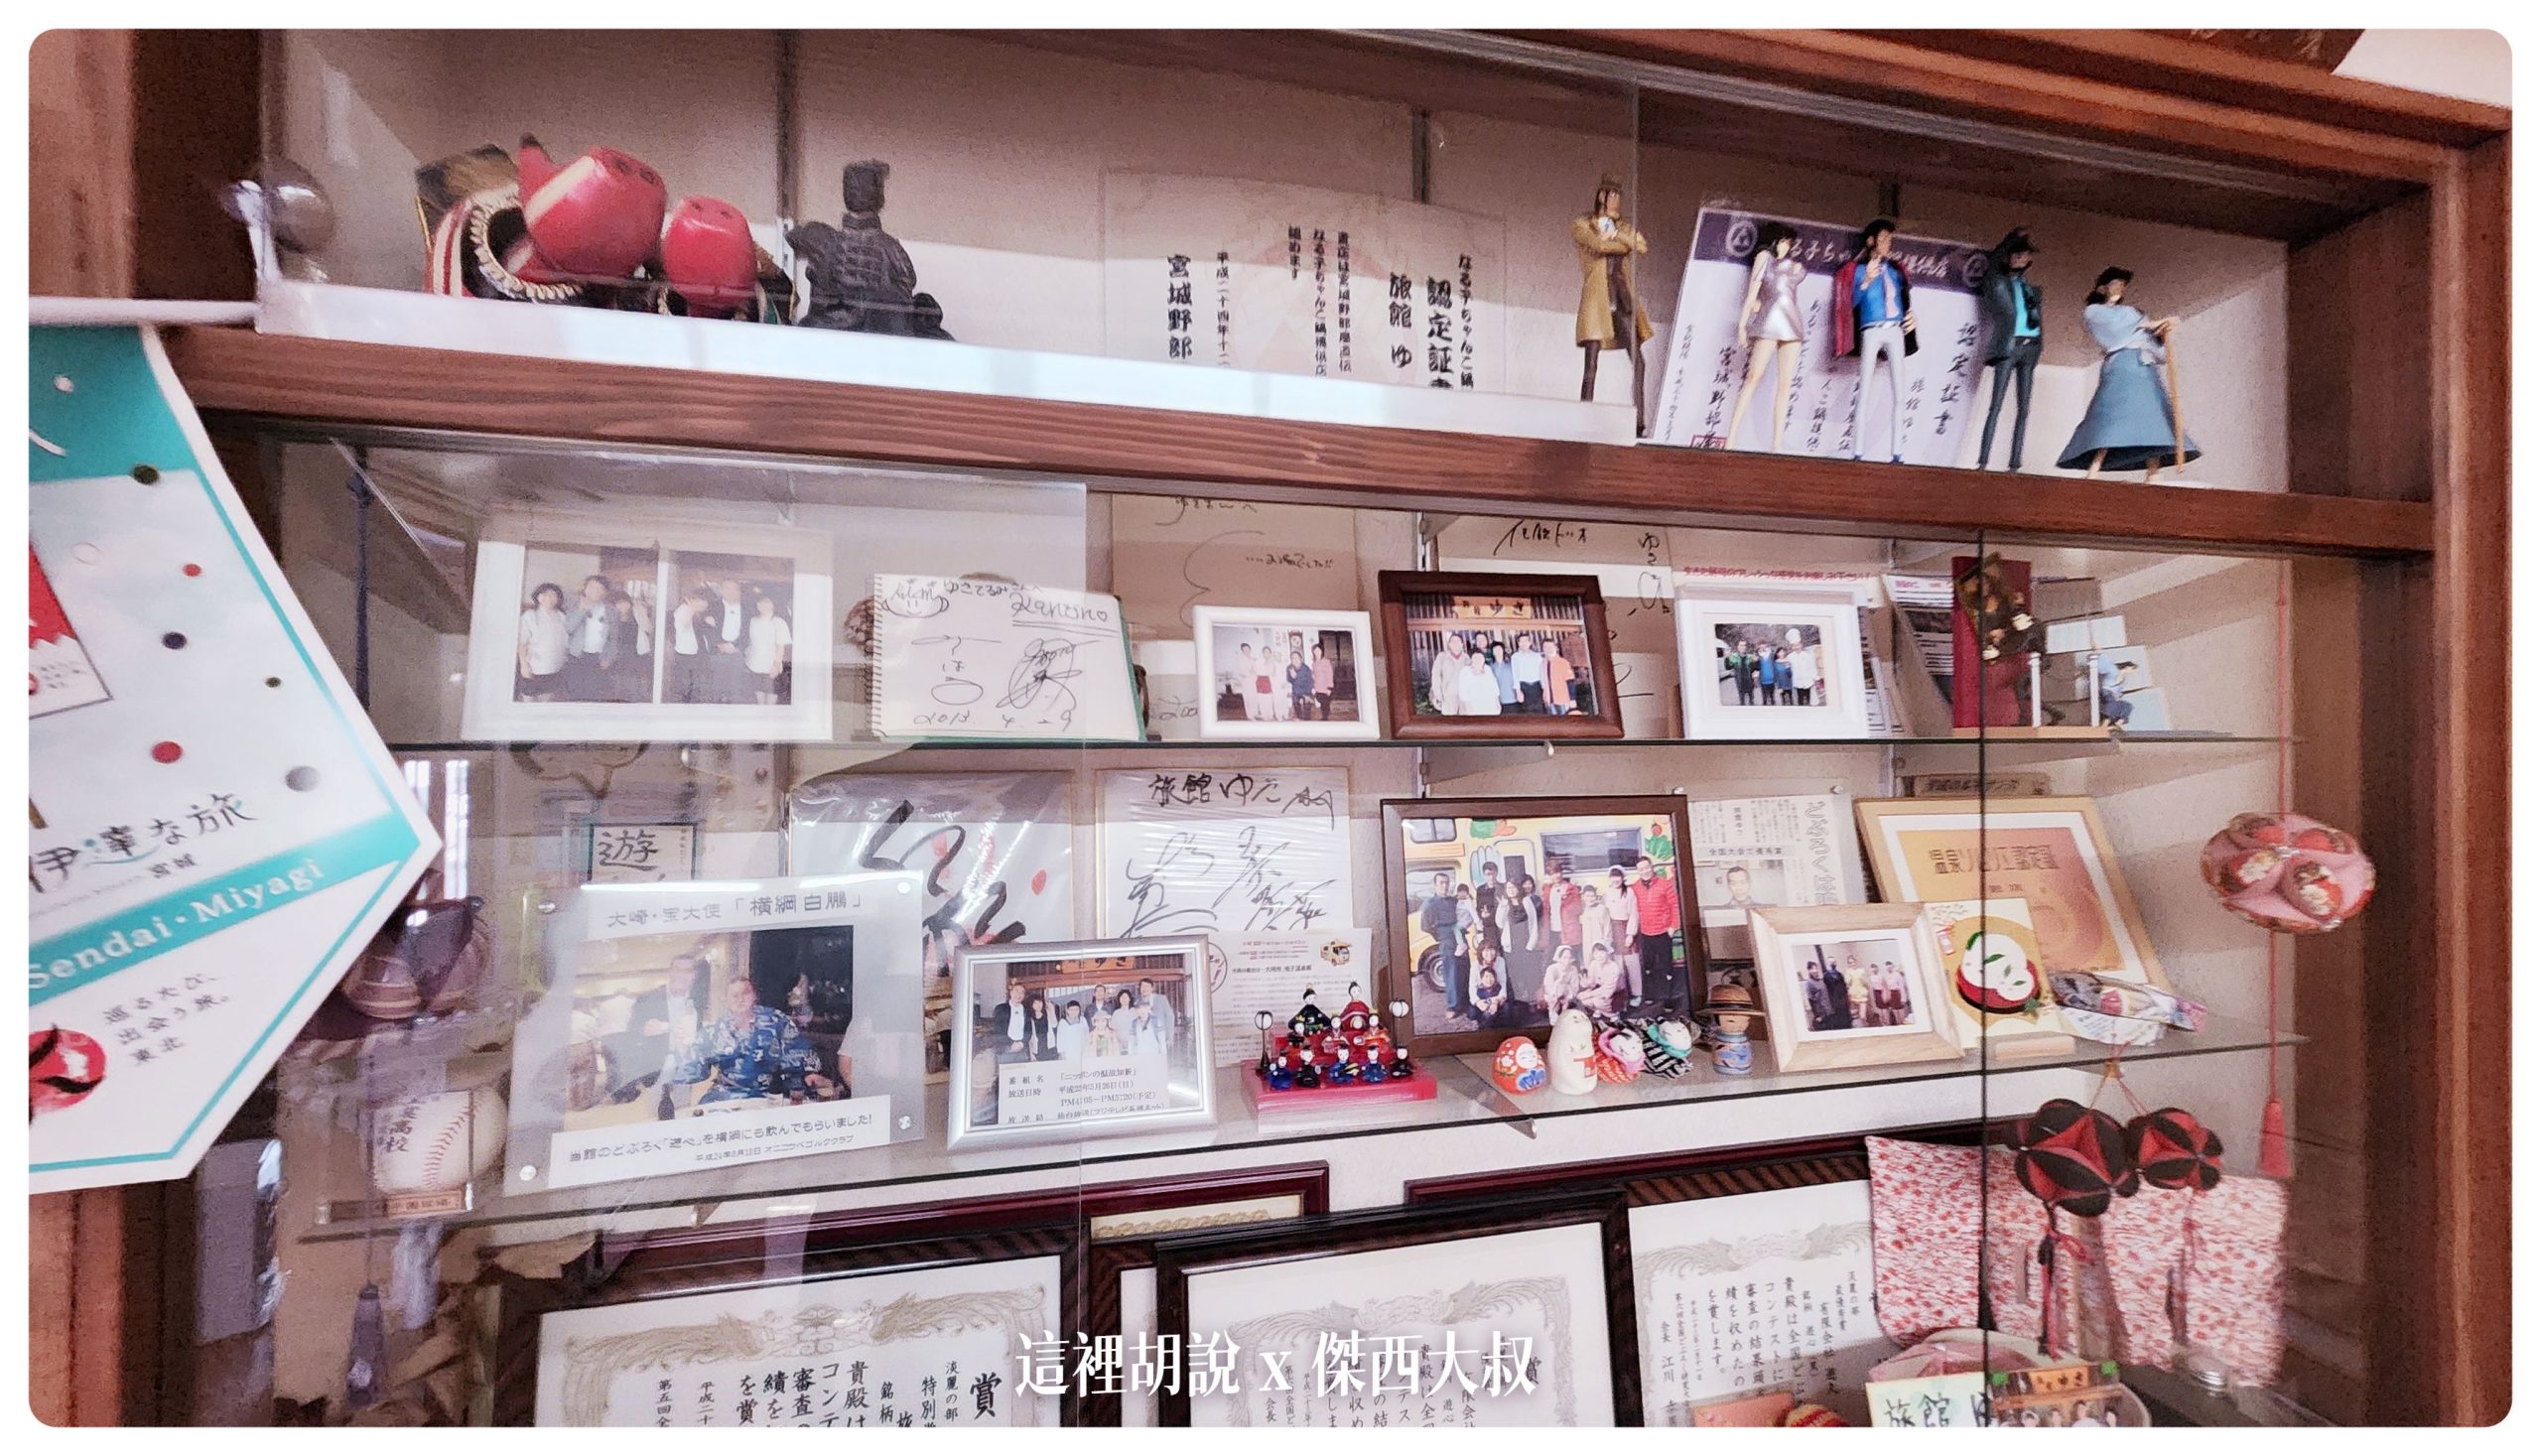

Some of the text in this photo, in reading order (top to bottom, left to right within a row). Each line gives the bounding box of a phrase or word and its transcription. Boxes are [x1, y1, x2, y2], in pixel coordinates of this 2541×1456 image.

[1389, 271, 1413, 330] 旅館
[790, 1367, 817, 1427] 審査
[879, 1381, 894, 1424] 銘柄
[969, 1371, 1003, 1420] 賞
